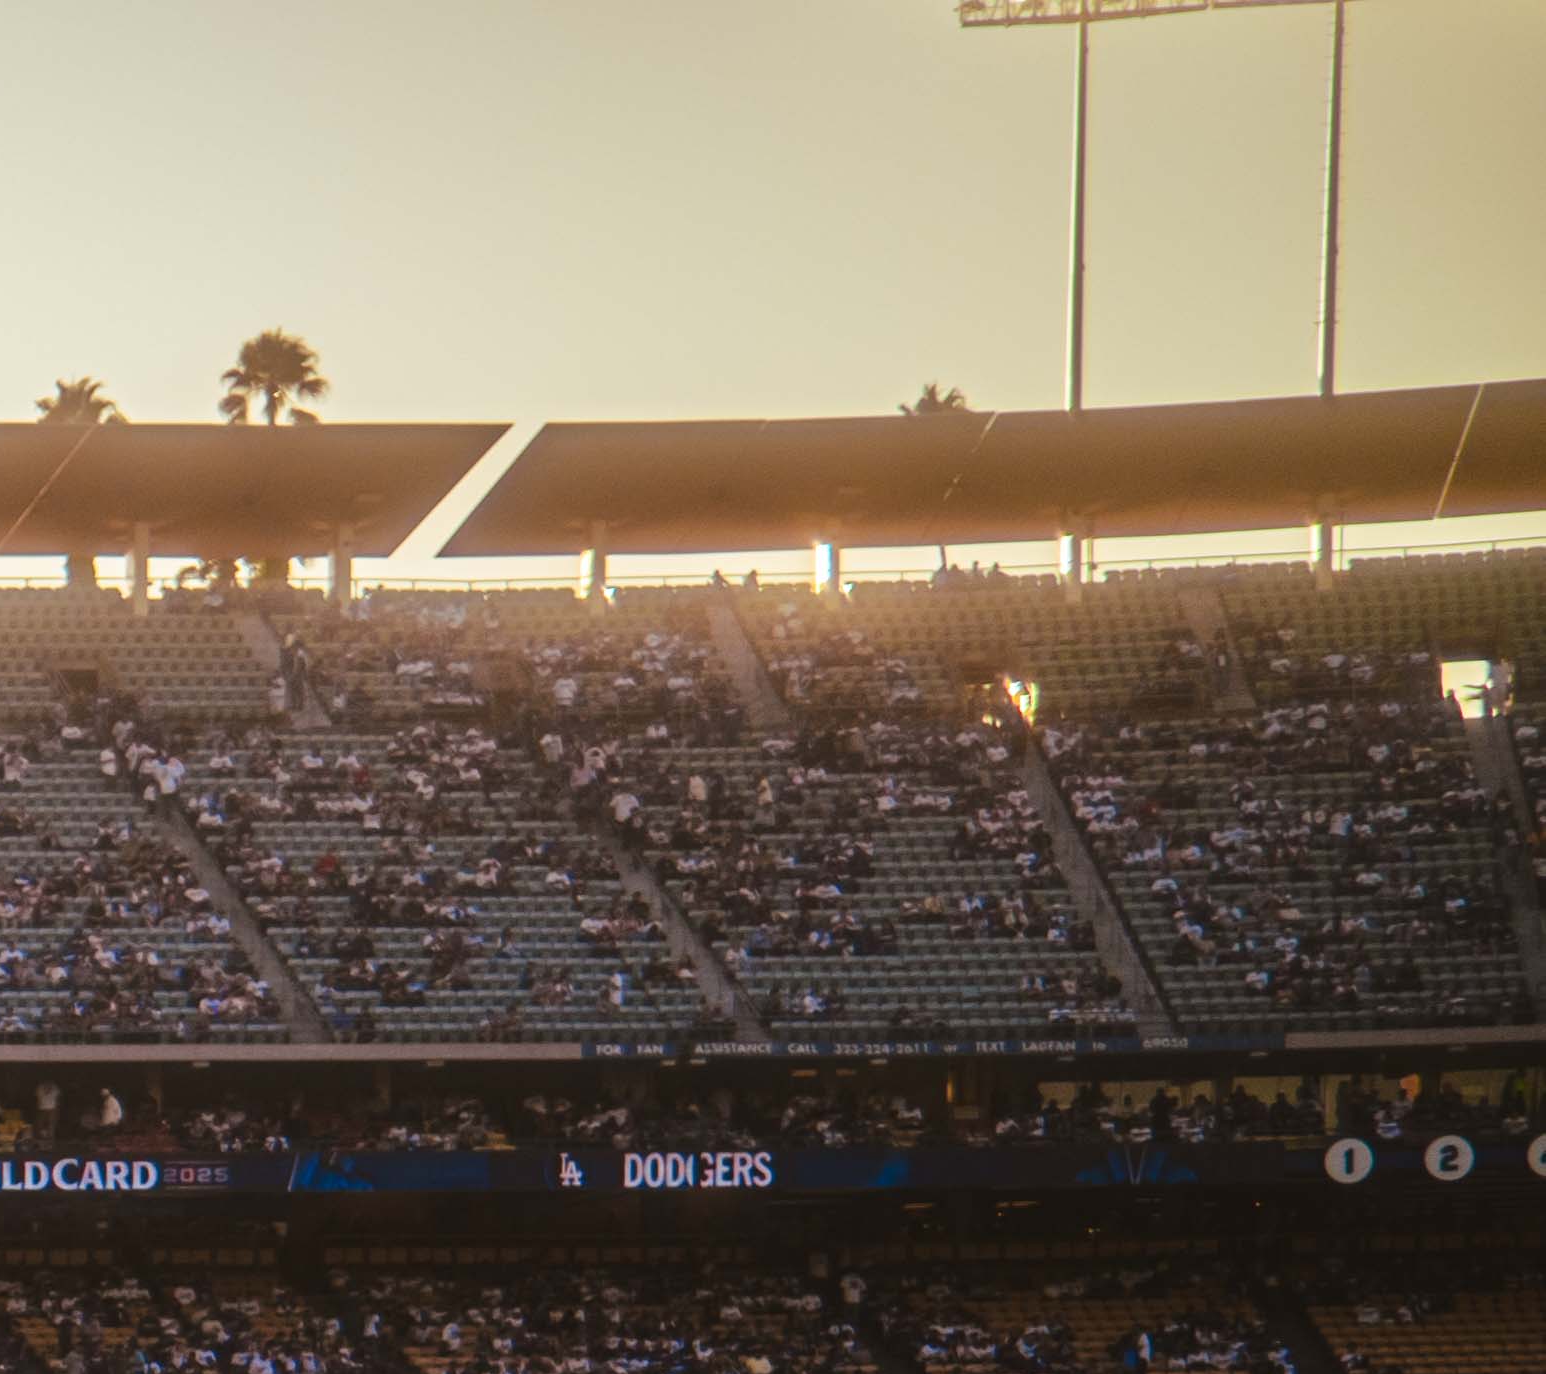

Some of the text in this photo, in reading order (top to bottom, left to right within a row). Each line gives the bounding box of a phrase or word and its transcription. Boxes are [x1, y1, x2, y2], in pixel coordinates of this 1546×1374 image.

[623, 1151, 774, 1188] DODGERS
[1439, 1145, 1459, 1172] 2
[164, 1166, 229, 1184] 2025
